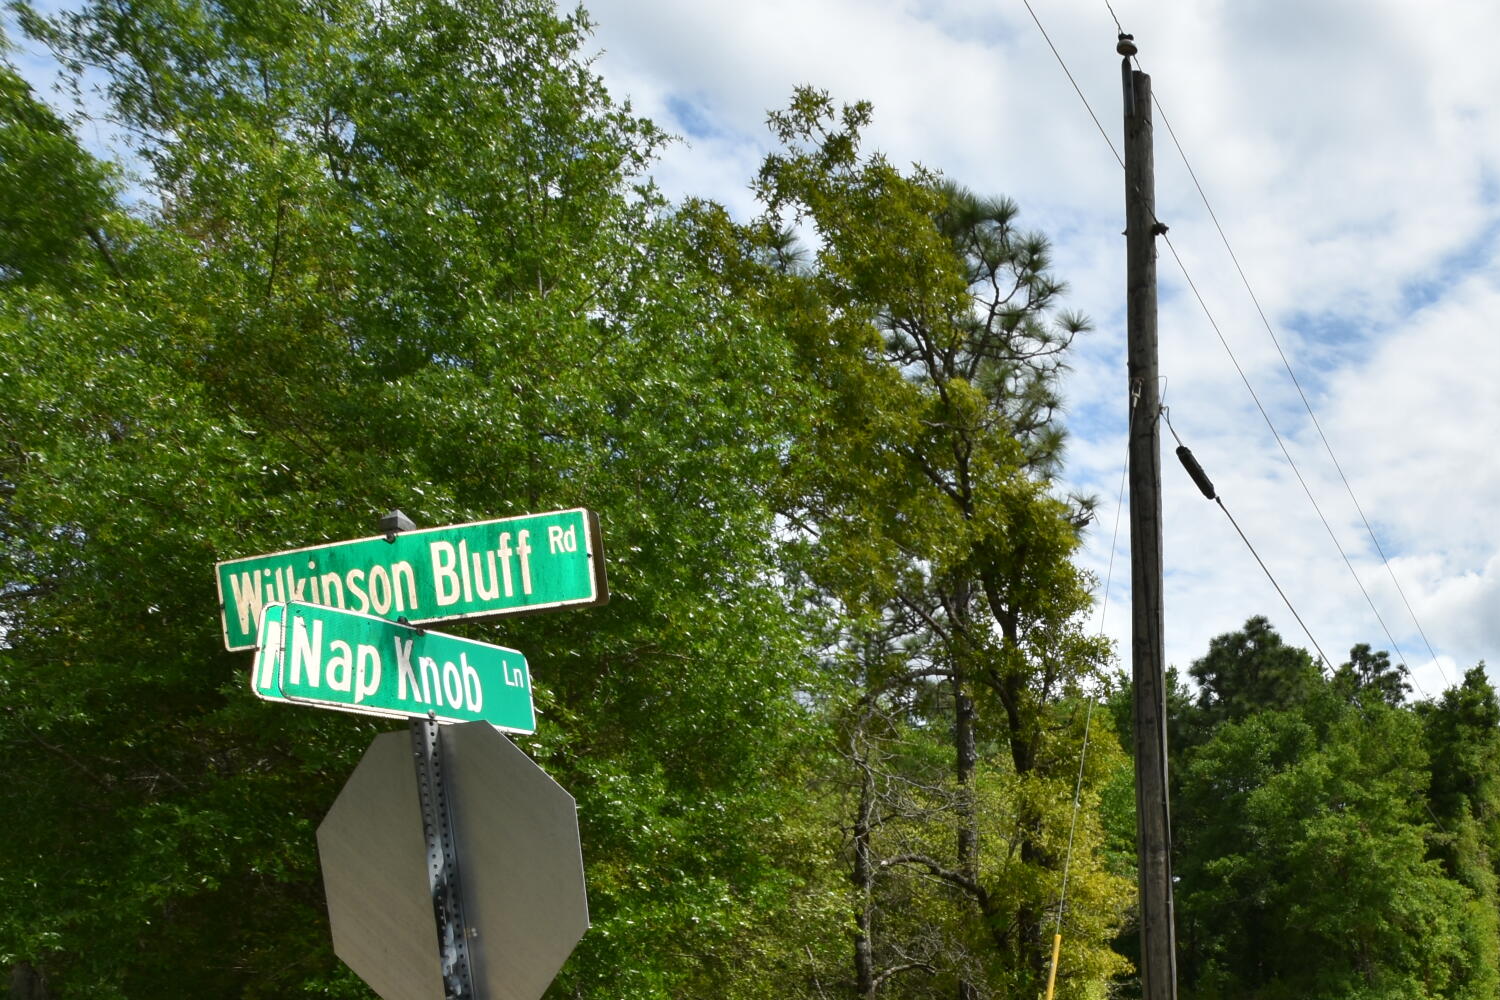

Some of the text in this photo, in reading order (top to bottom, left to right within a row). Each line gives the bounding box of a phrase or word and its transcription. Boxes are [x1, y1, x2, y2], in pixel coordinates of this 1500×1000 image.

[430, 530, 532, 605] Bluff
[548, 525, 576, 554] Rd
[290, 615, 381, 703] Nap
[394, 636, 483, 713] Knob
[502, 659, 524, 688] Ln
